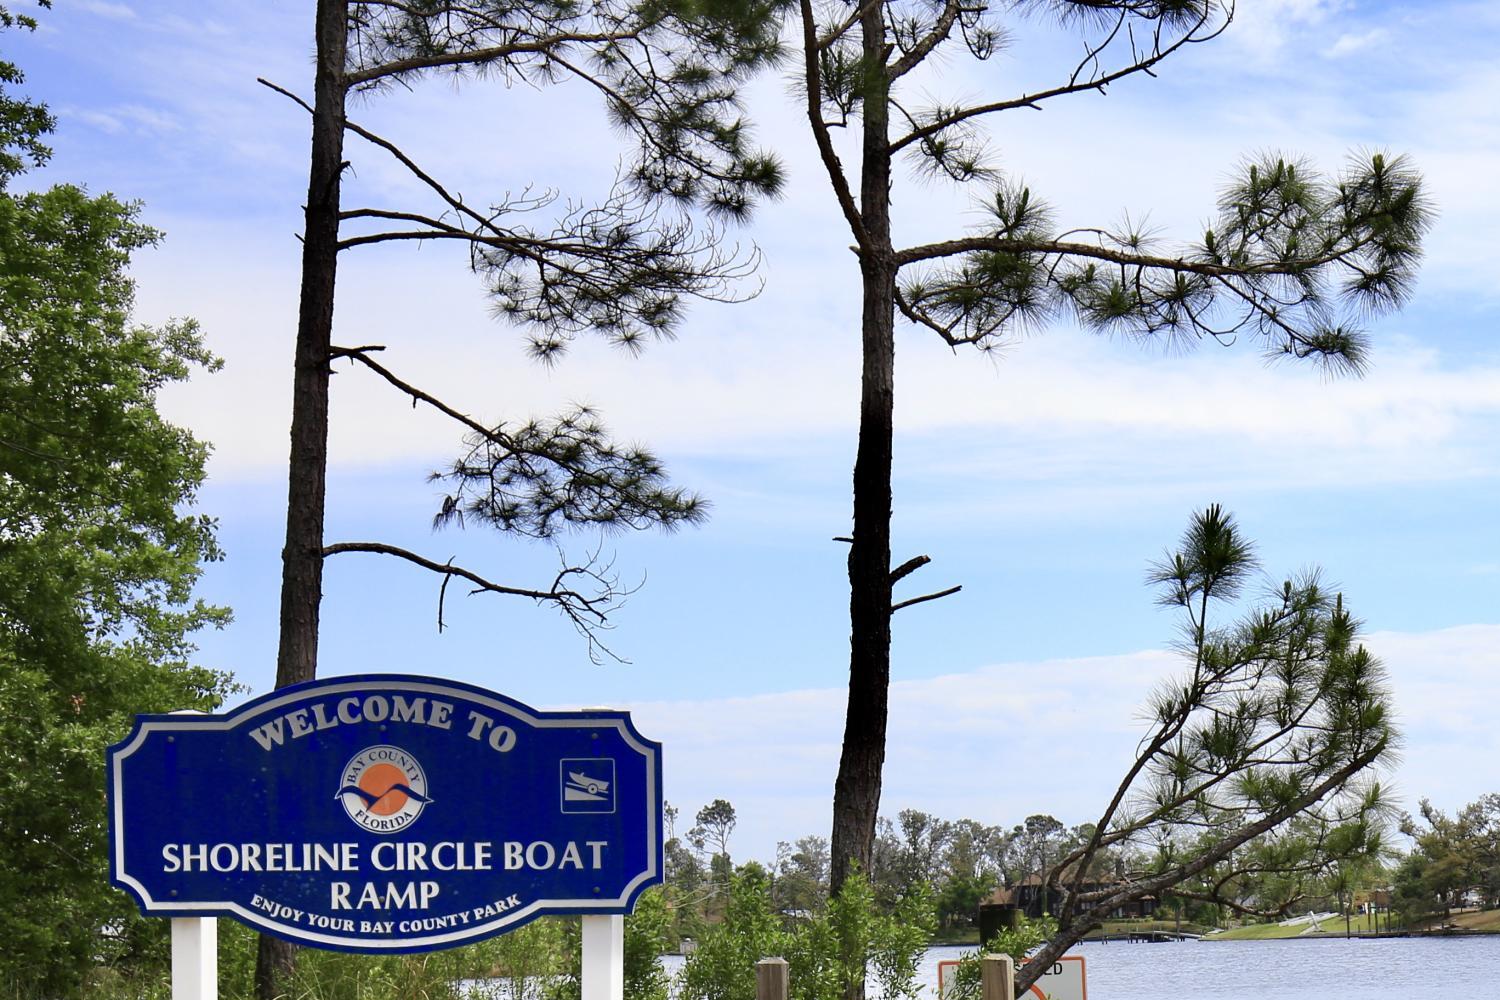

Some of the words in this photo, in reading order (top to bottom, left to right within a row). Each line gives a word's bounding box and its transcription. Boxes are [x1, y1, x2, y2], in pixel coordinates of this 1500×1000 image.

[249, 695, 454, 752] WELCOME
[468, 711, 517, 753] TO
[346, 757, 366, 783] BAY
[368, 749, 420, 782] COUNTY
[355, 809, 413, 830] FLORIDA
[162, 843, 359, 872] SHORELINE
[371, 842, 492, 871] CIRCLE
[504, 841, 608, 870] BOAT
[331, 881, 440, 910] RAMP
[250, 893, 305, 922] ENJOY
[307, 912, 355, 932] YOUR
[359, 920, 395, 934] BAY
[399, 911, 470, 933] COUNTY
[474, 893, 522, 921] PARK
